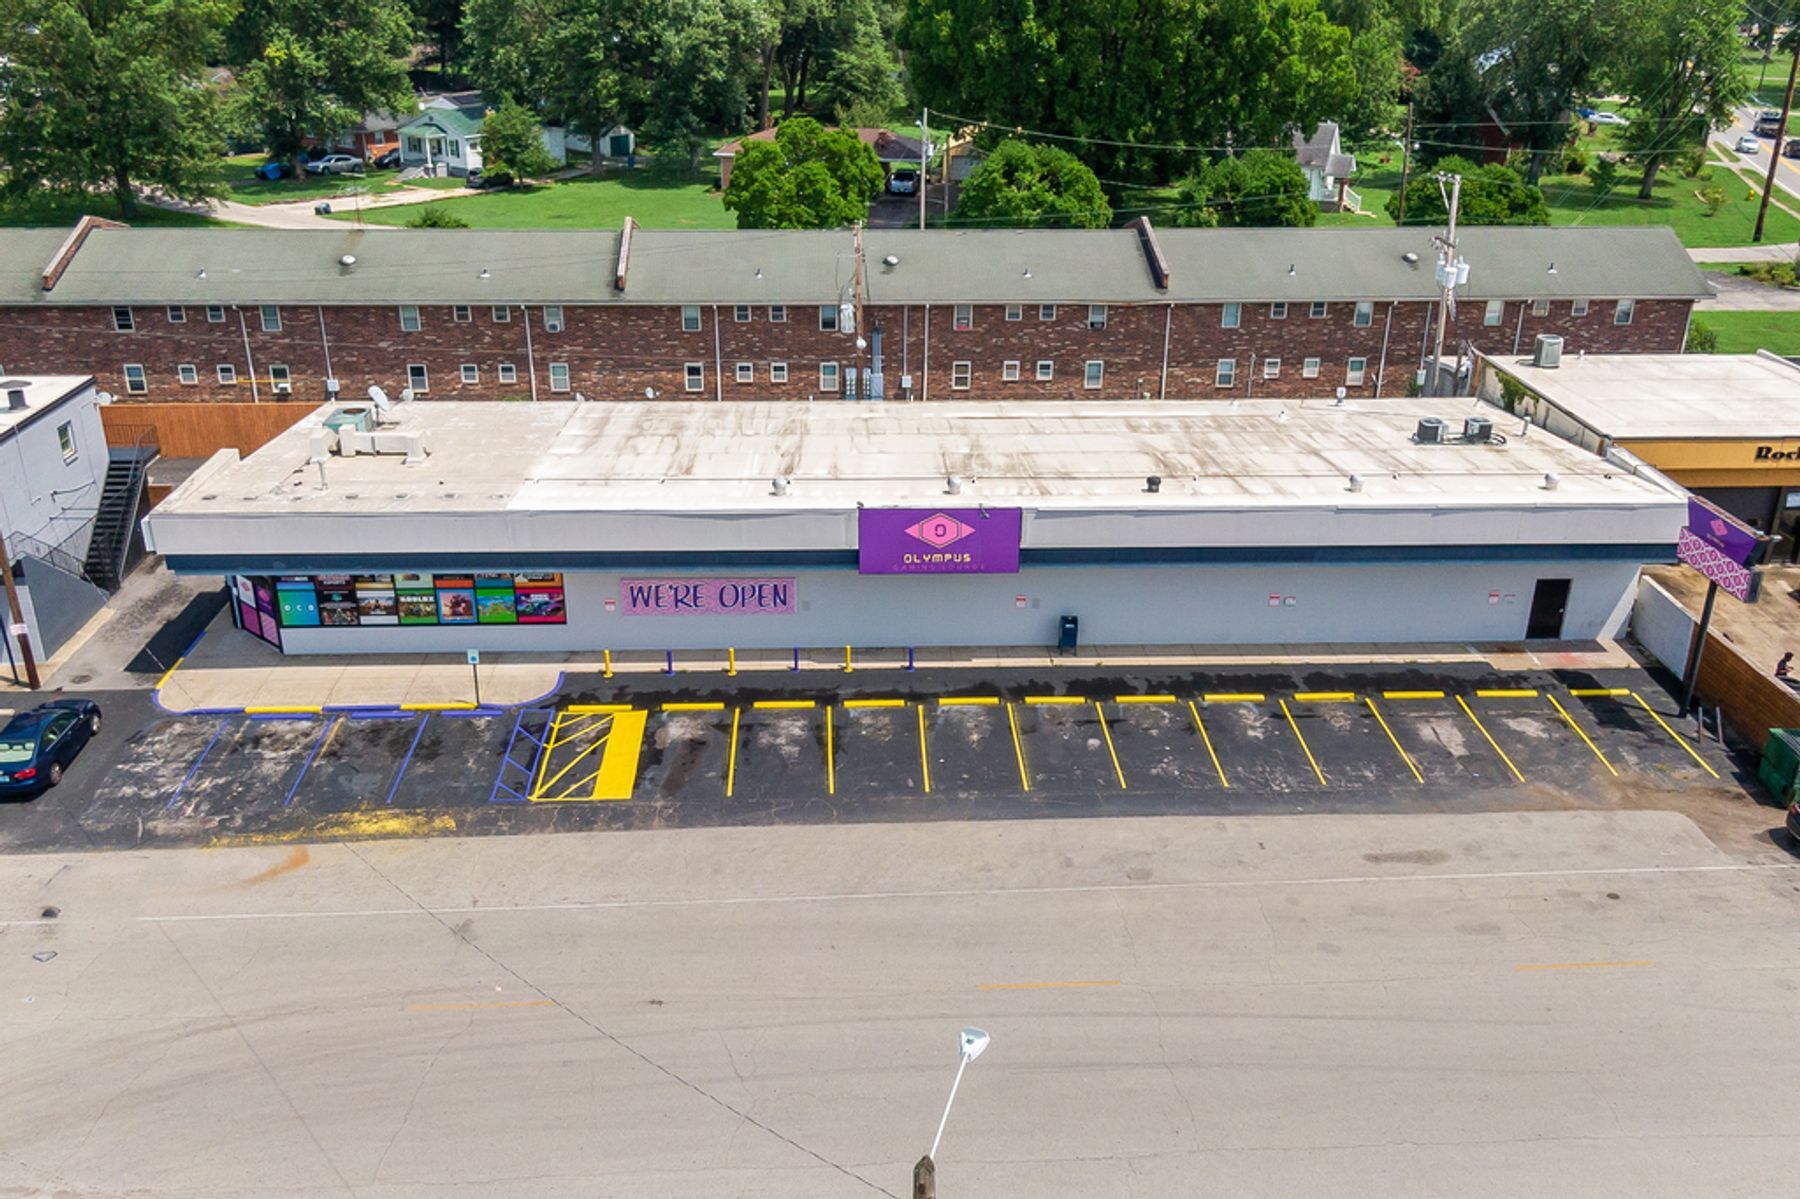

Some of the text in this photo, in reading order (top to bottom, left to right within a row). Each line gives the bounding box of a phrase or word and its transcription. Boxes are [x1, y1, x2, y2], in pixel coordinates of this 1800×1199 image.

[903, 553, 971, 563] OLYMPUS
[630, 584, 705, 608] WE'RE
[719, 583, 787, 608] OPEN
